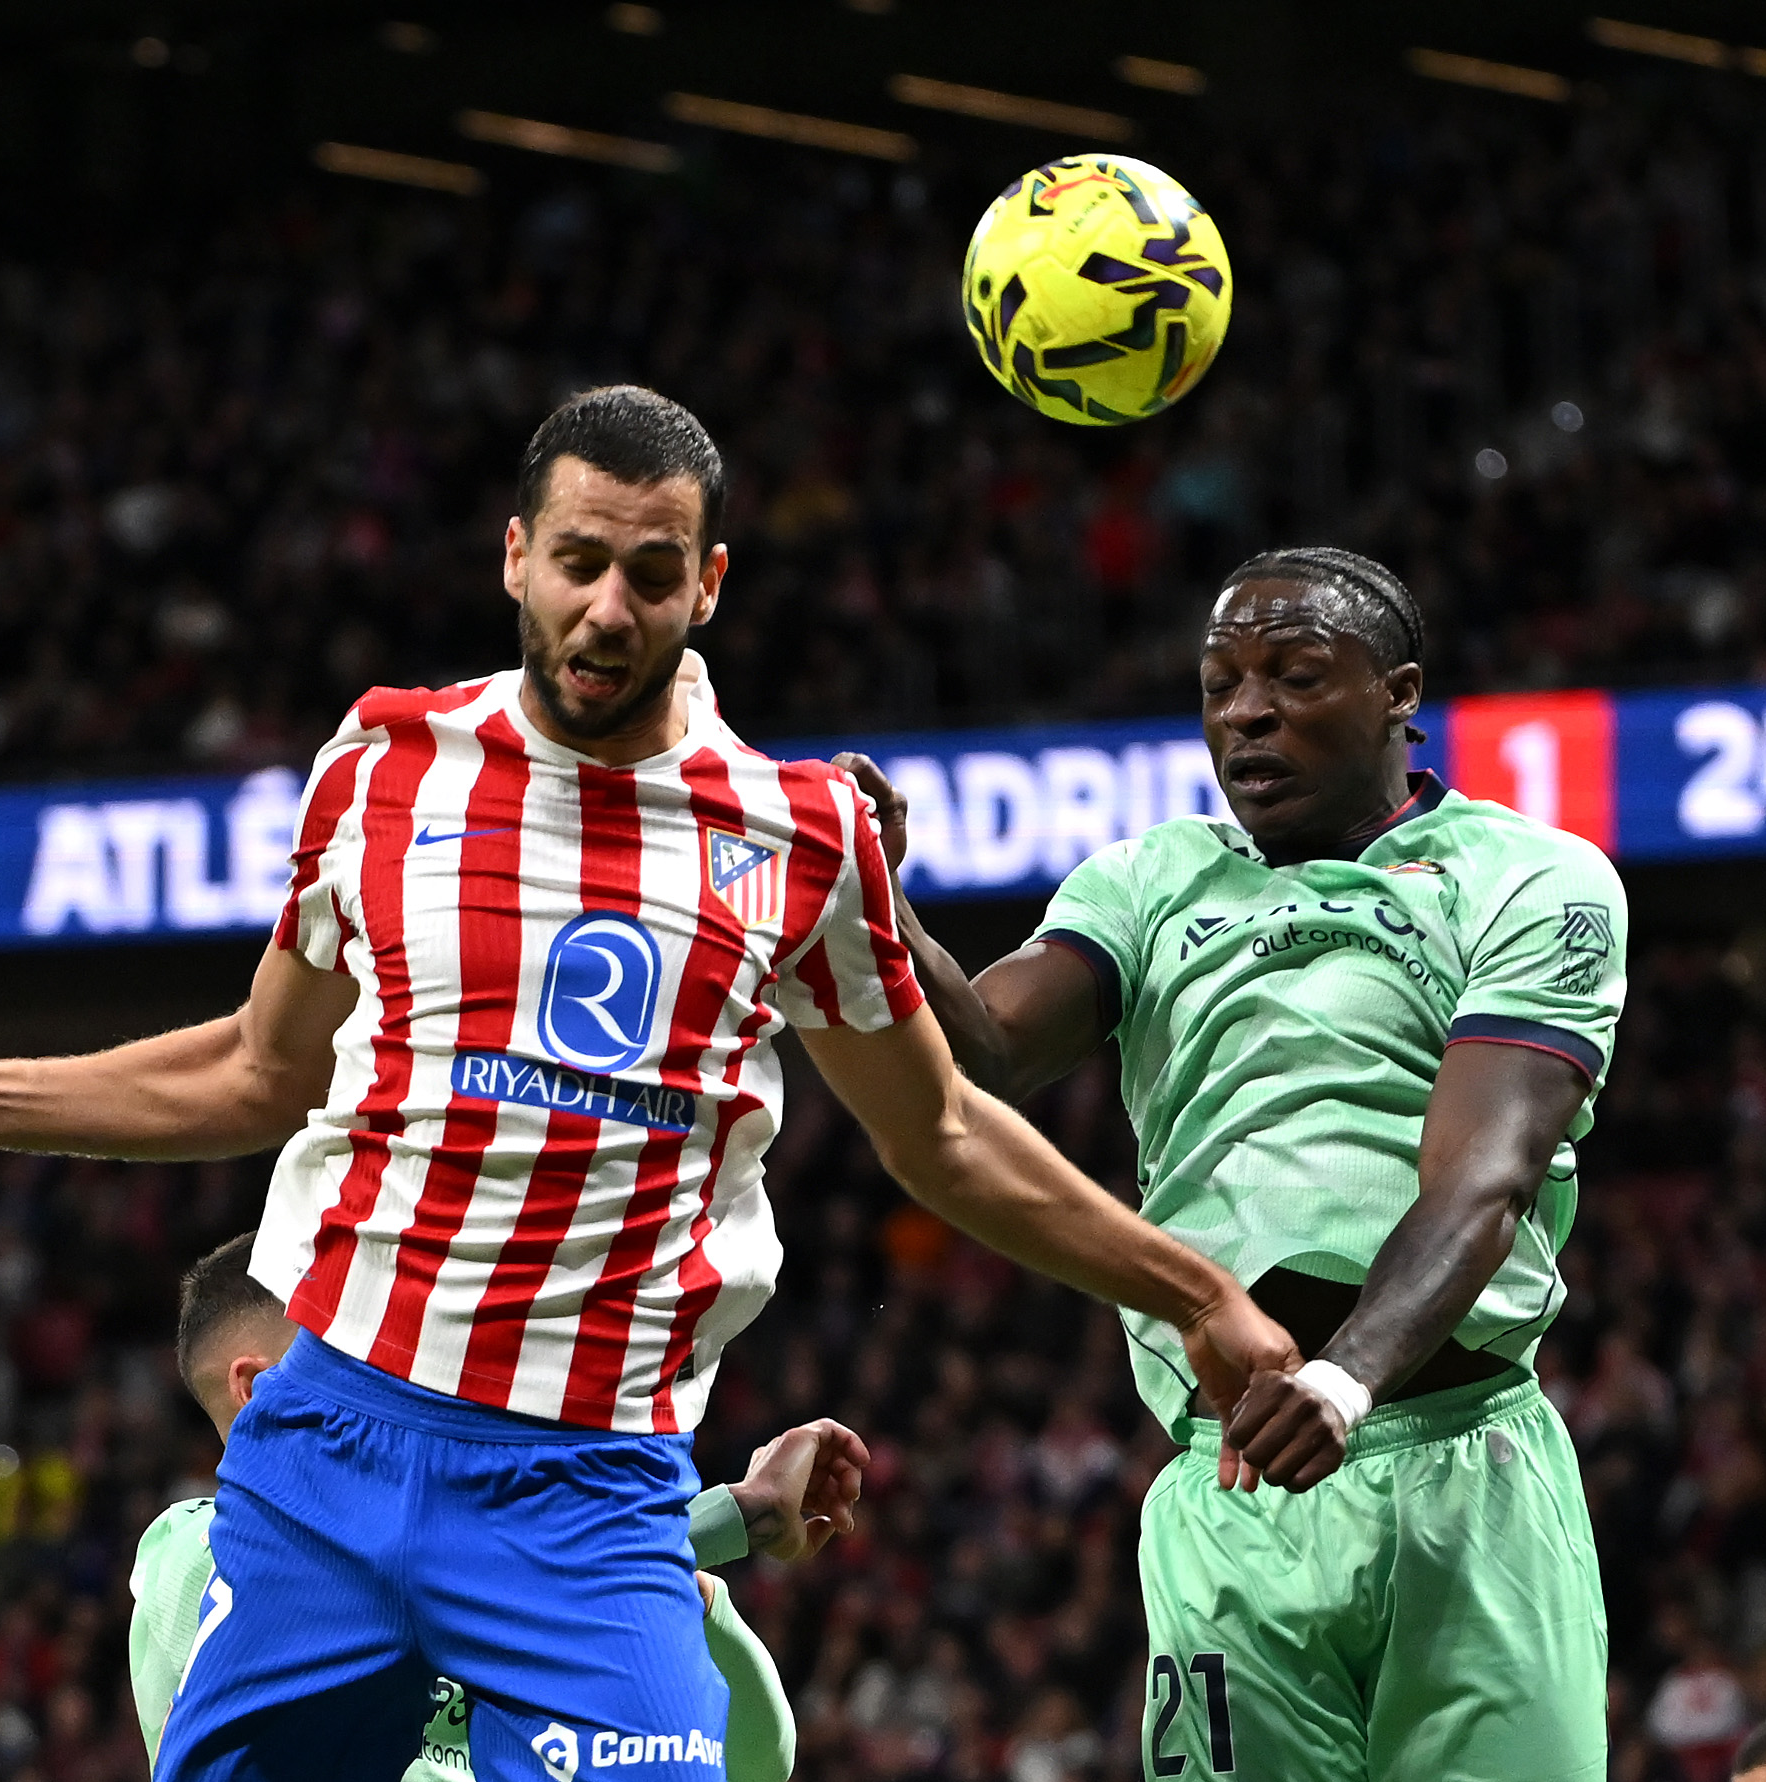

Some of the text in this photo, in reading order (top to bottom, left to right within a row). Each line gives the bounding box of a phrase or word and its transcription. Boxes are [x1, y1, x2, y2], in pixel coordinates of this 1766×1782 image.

[1499, 720, 1561, 827] 1
[461, 1055, 687, 1128] RIYADH AIR
[1151, 1652, 1235, 1778] 21
